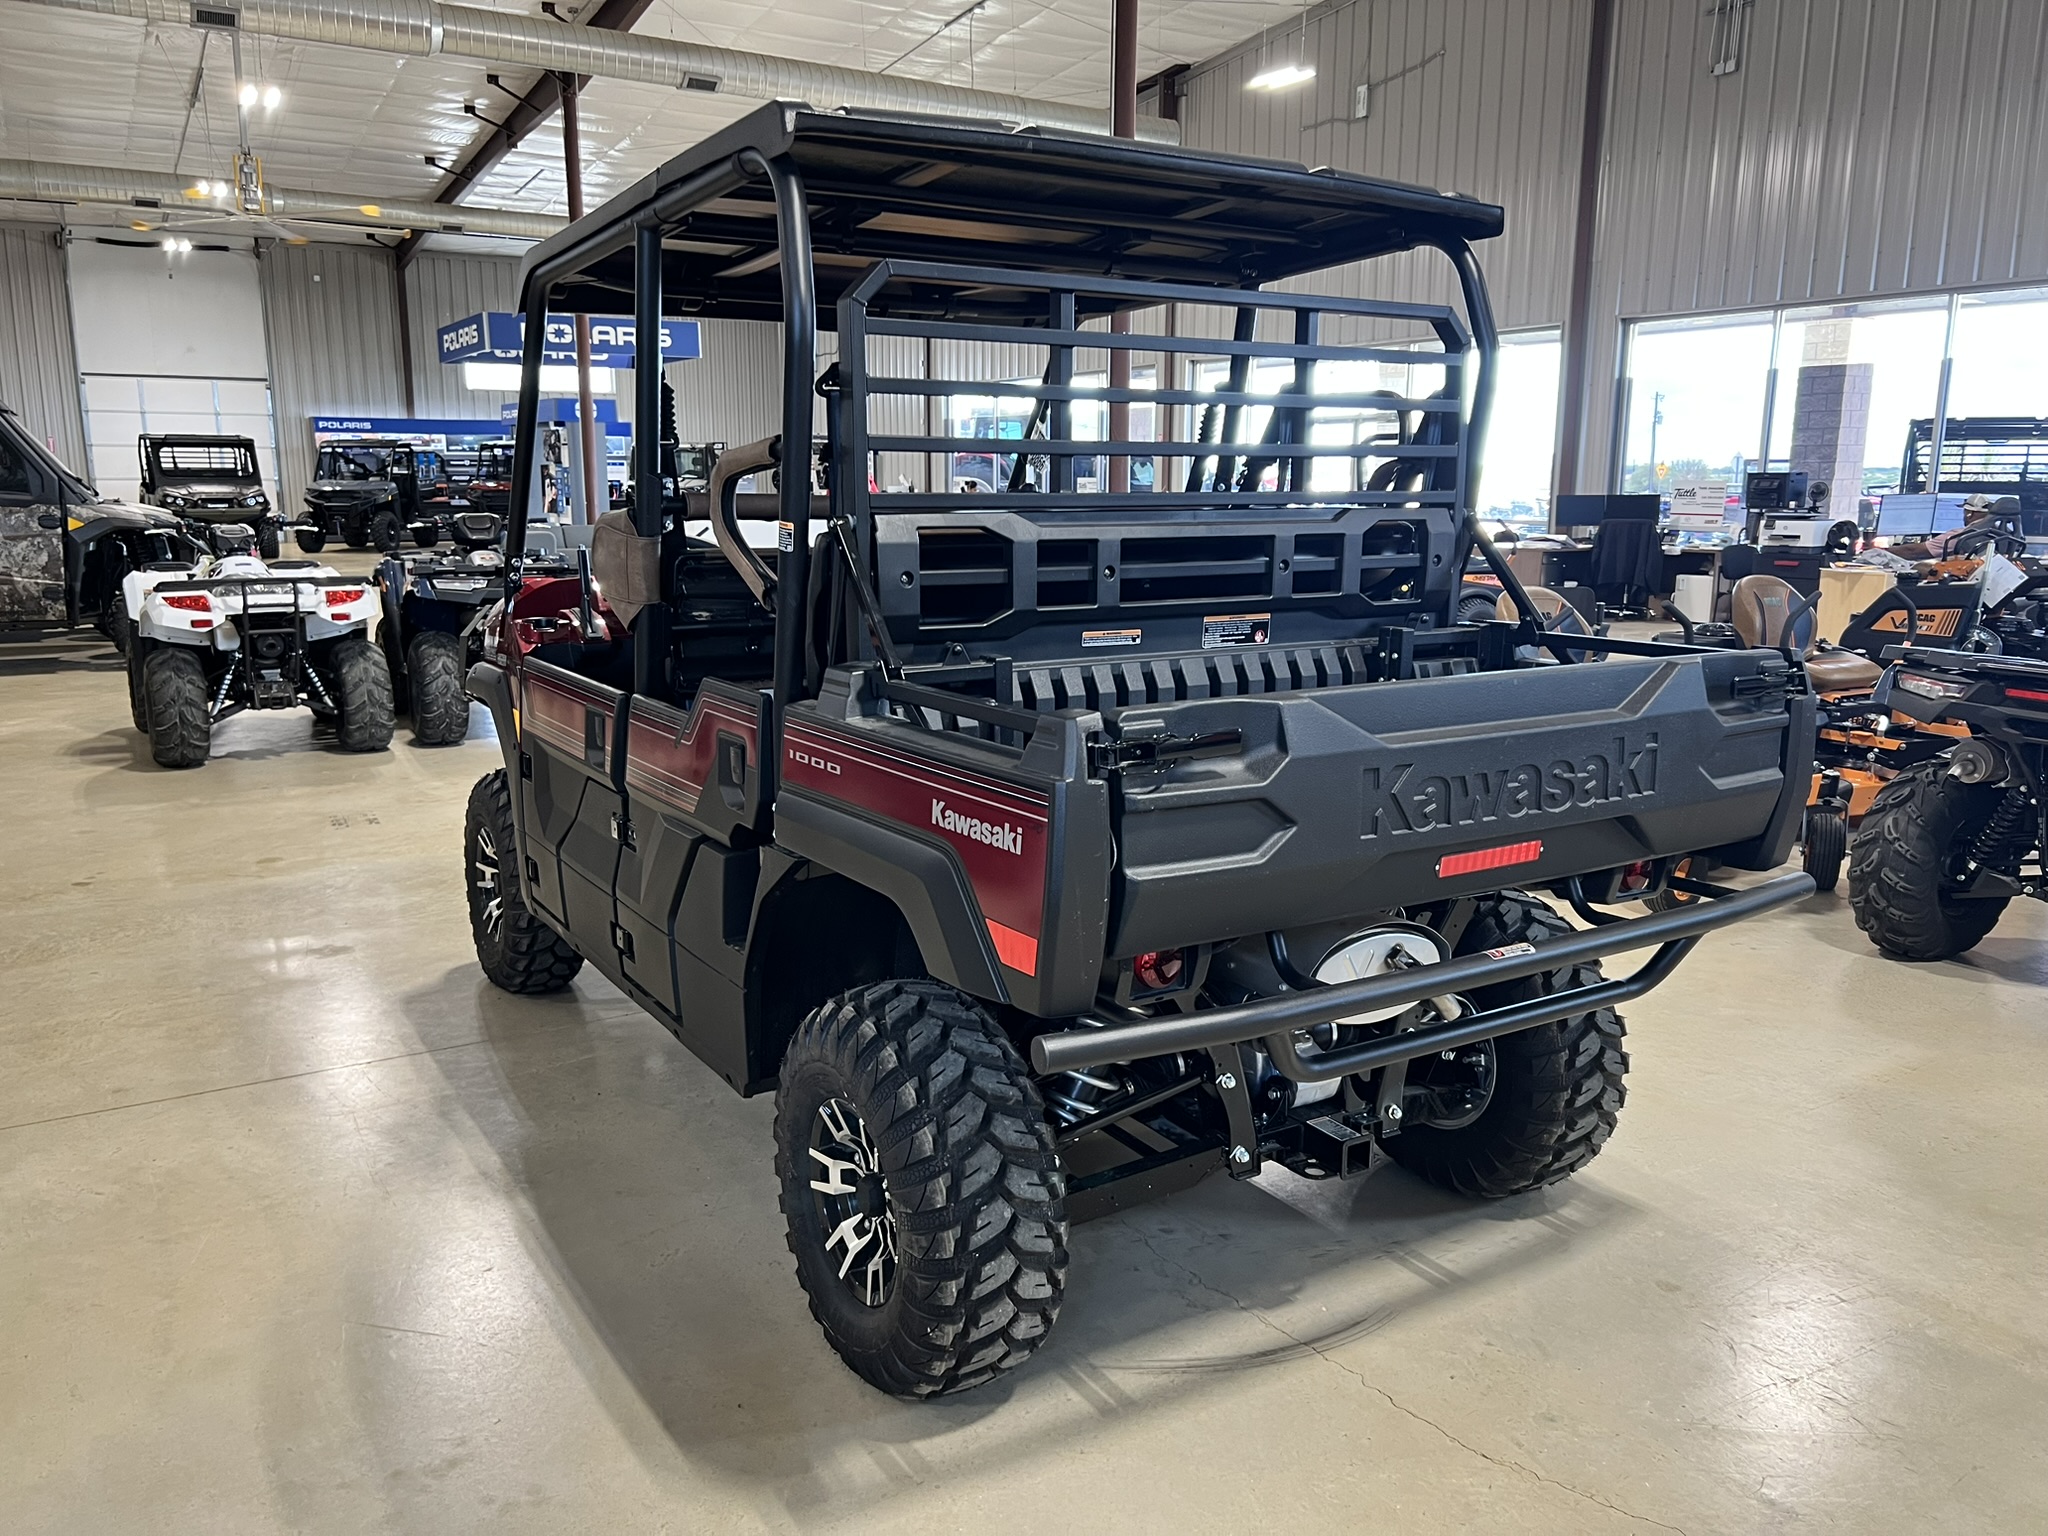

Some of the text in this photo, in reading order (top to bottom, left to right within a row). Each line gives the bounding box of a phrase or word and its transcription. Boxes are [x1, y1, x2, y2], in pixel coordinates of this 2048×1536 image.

[443, 323, 479, 353] POLARIS
[521, 321, 673, 348] OARS
[318, 421, 372, 430] POLARIS
[1916, 613, 1936, 623] CAG
[789, 748, 842, 776] 1000
[1360, 731, 1659, 840] Kawasaki
[931, 798, 1023, 856] Kawasaki
